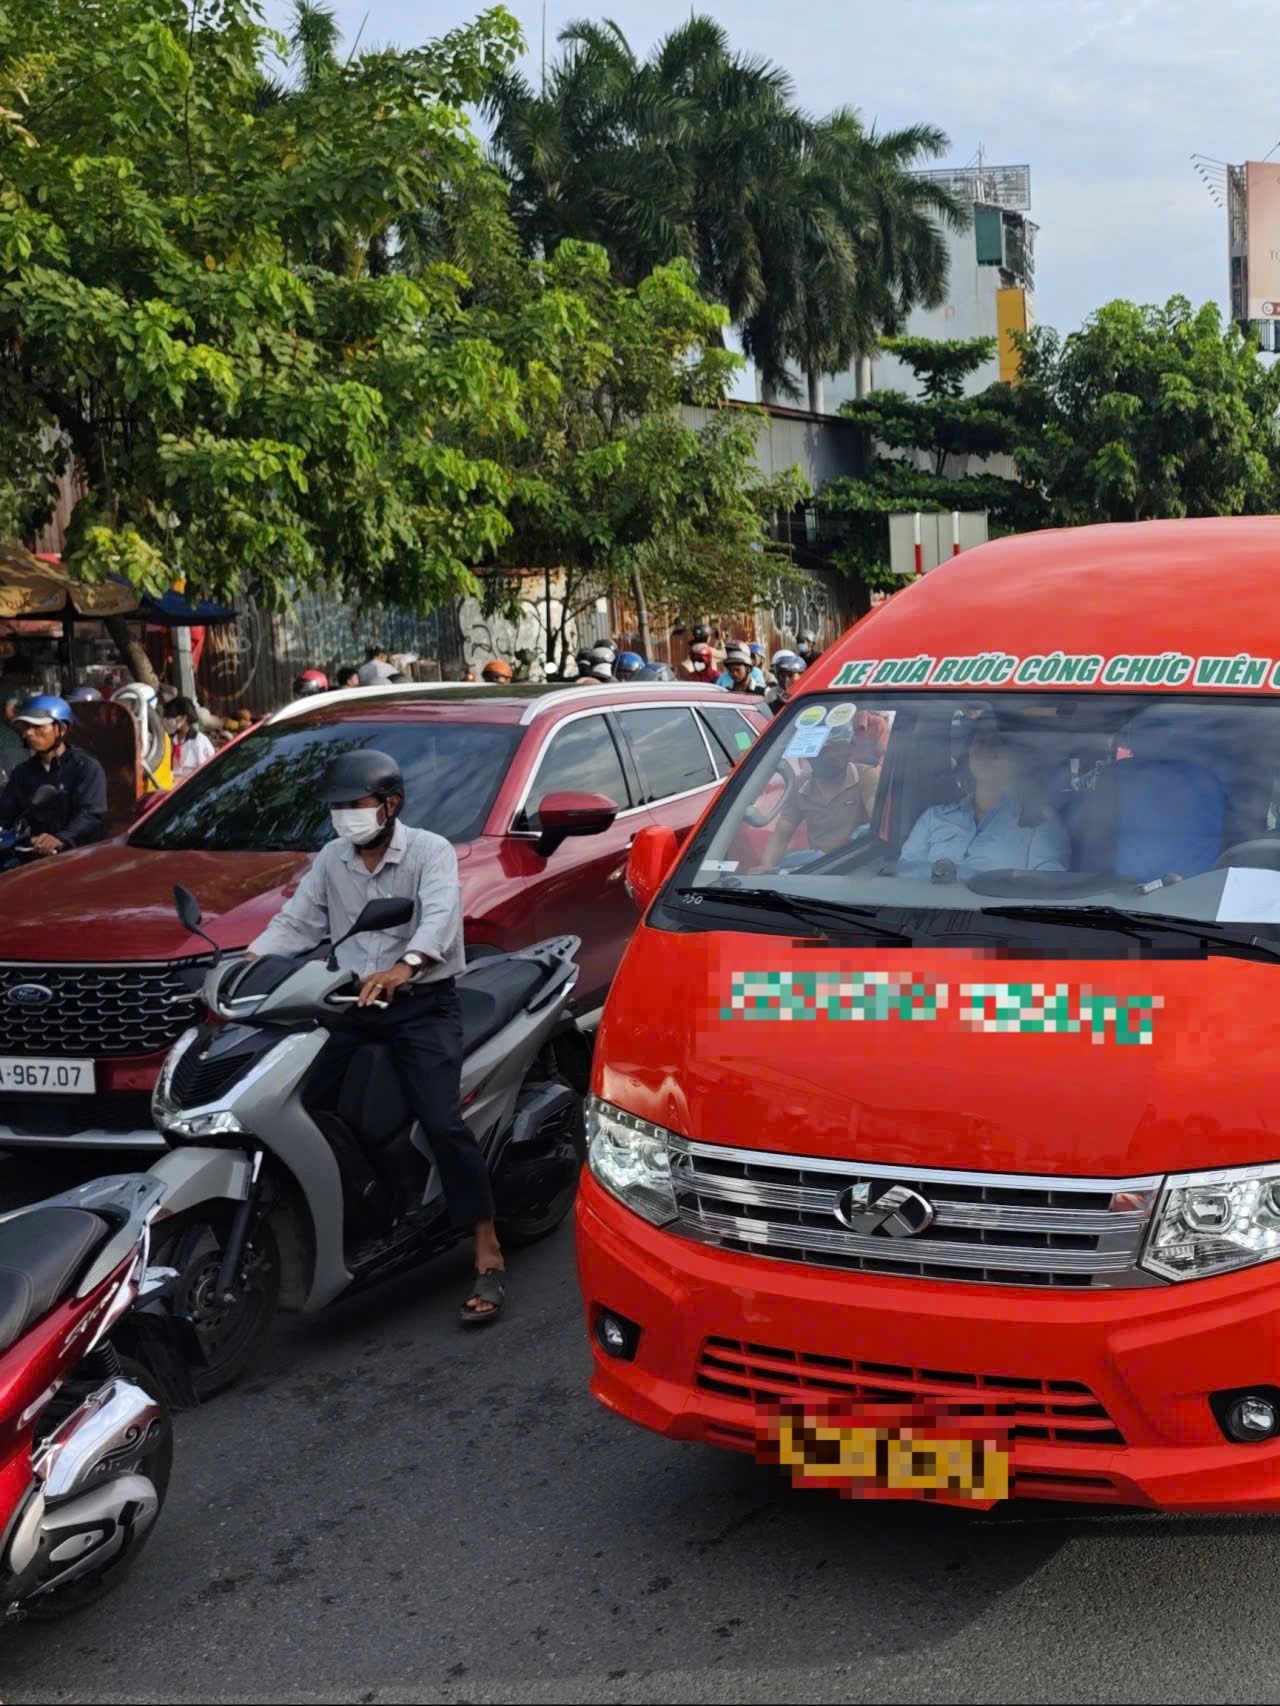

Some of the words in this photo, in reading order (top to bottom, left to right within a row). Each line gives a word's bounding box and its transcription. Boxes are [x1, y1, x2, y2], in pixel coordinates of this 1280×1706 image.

[834, 661, 873, 686] XE
[870, 655, 932, 685] ĐƯA
[932, 652, 1016, 683] RƯỚC
[1017, 653, 1103, 683] CÔNG
[1105, 653, 1191, 684] CHỨC
[1196, 655, 1267, 685] VIÊN
